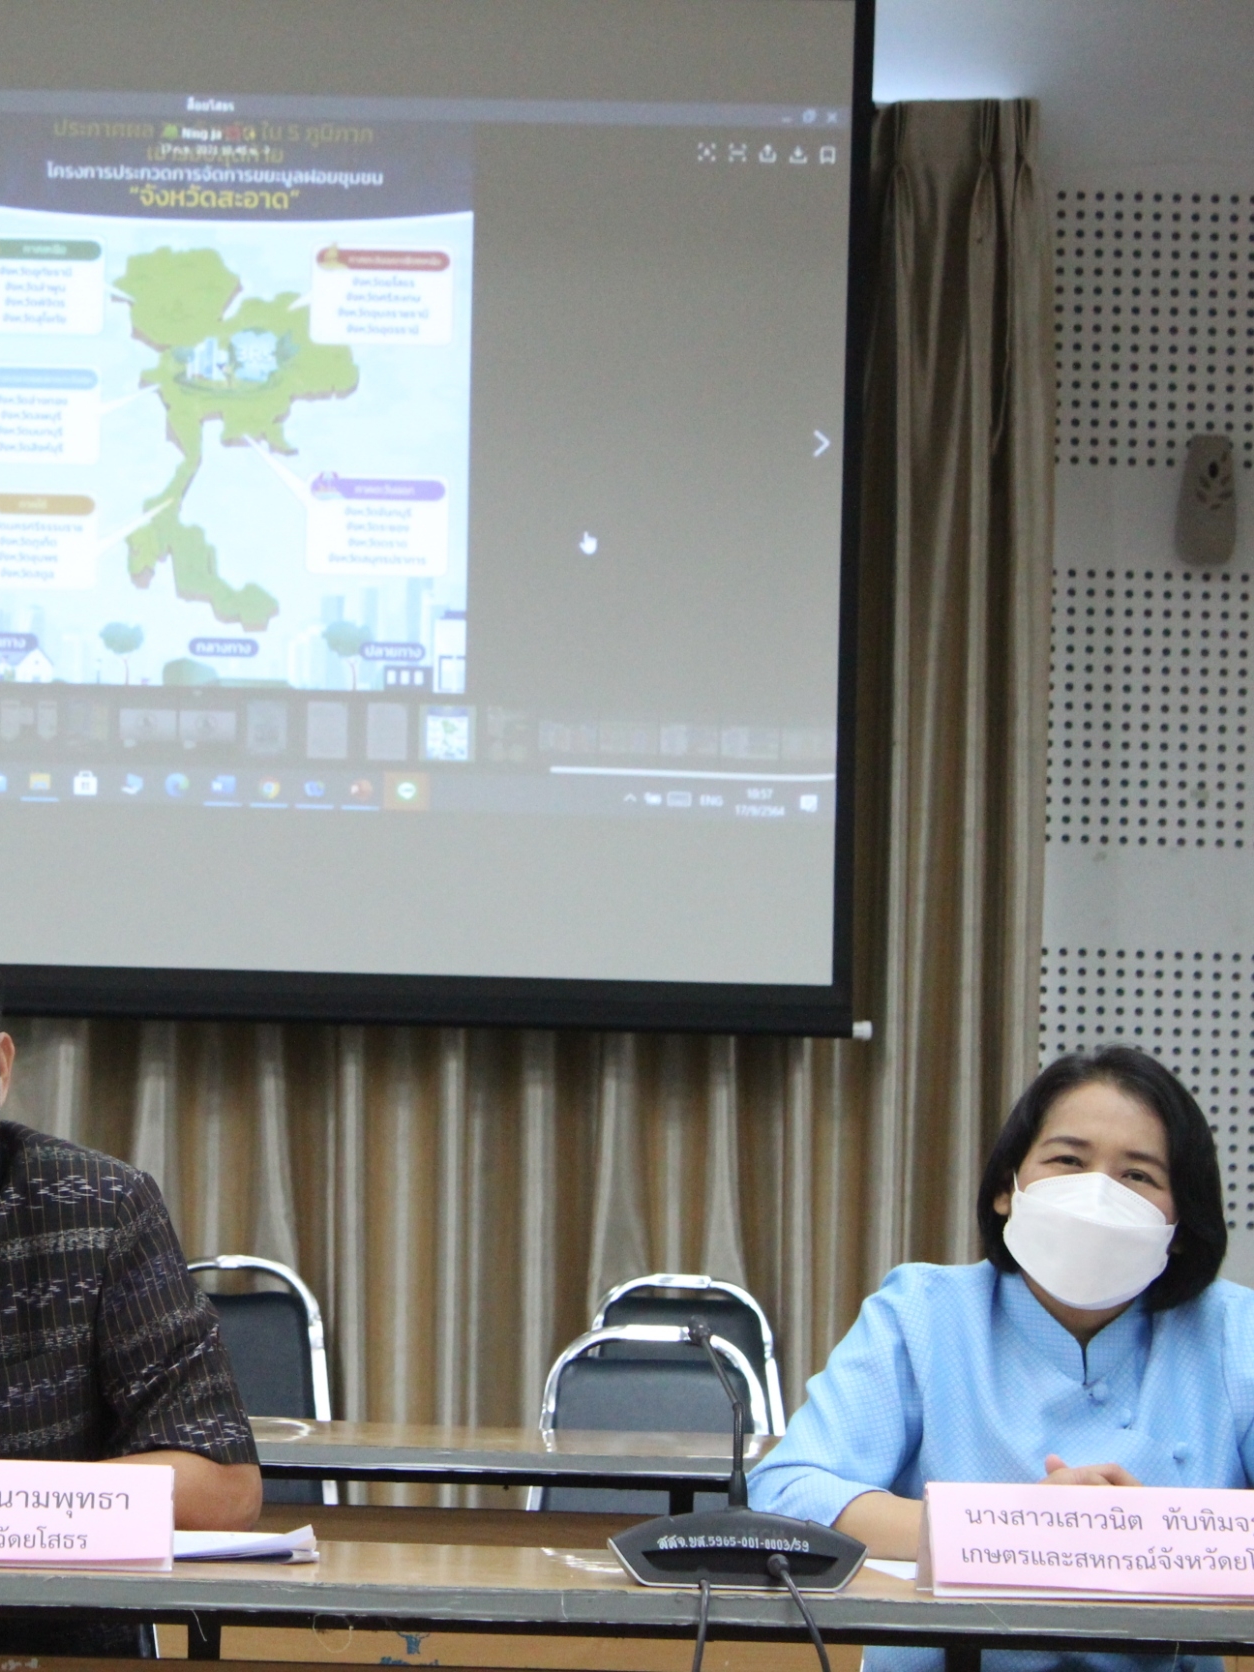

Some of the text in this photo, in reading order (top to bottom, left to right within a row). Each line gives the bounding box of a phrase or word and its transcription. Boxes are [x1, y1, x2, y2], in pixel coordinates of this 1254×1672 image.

[47, 161, 384, 188] โครงการประกวดการจัดการขยะมูลฝอยชุมชน
[965, 1506, 1254, 1537] นางสาวเสาวนิต ทับทิมจ
